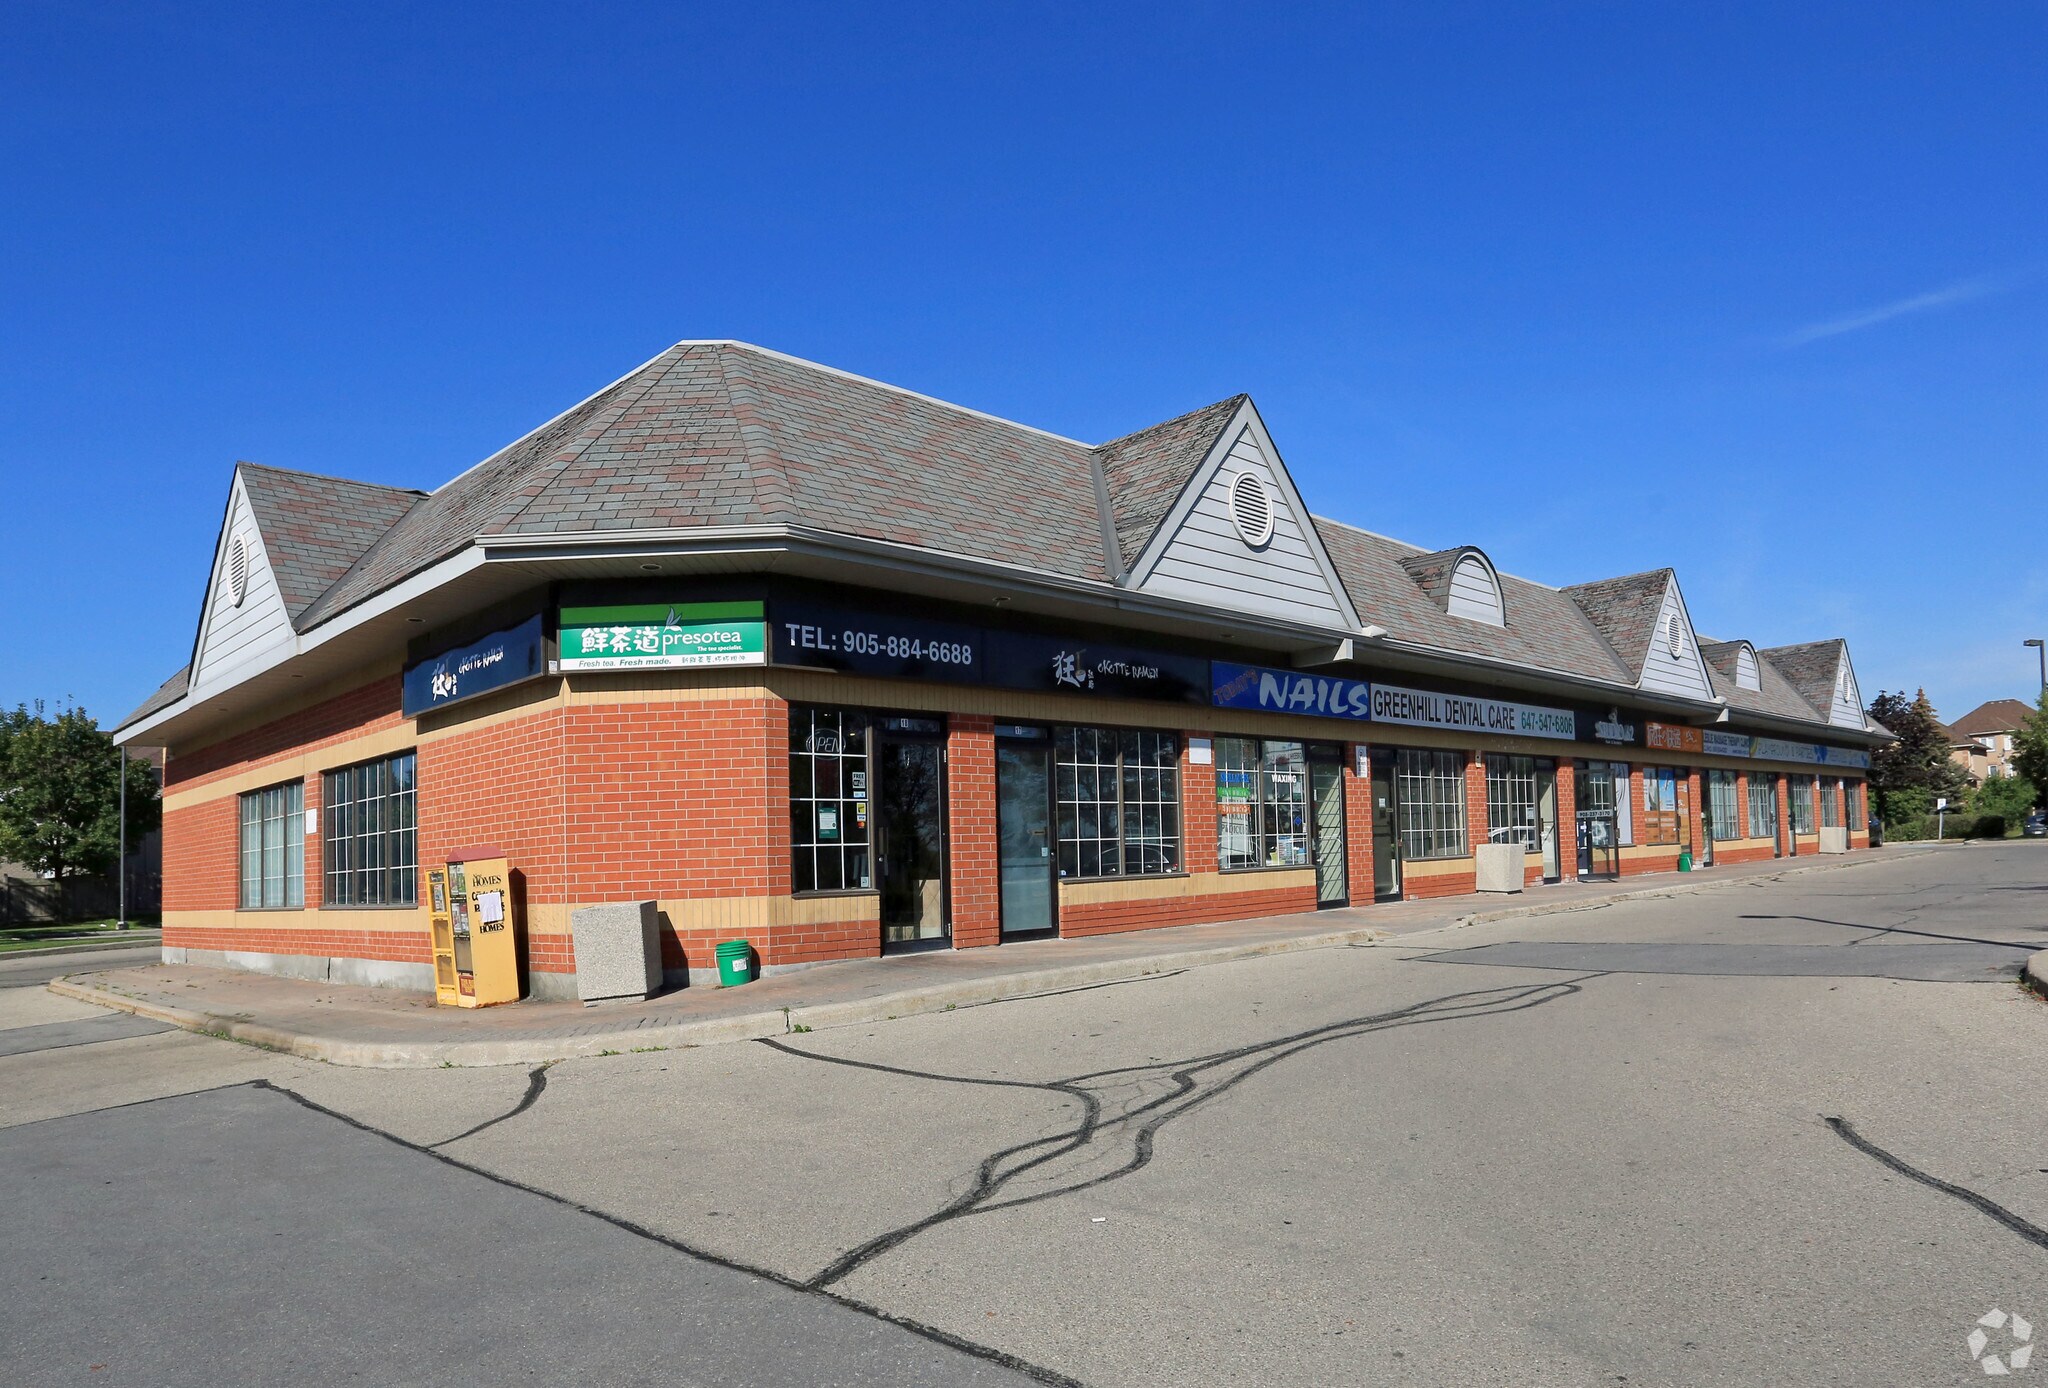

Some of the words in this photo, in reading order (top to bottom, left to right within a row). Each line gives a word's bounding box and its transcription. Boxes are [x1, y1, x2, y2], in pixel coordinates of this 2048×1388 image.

[581, 626, 659, 653] 鮮茶道
[663, 631, 741, 655] presotea
[786, 623, 837, 650] TEL:
[843, 630, 972, 665] 905-884-6688
[579, 659, 600, 668] Fresh
[645, 658, 672, 666] made.
[1132, 666, 1158, 679] RAMEN
[1259, 672, 1369, 717] NAILS
[1374, 690, 1441, 722] GREENHILL
[1444, 699, 1485, 727] DENTAL
[1488, 705, 1515, 730] CARE
[1521, 711, 1574, 735] 647-547-6806
[808, 736, 841, 753] OPEN
[1271, 774, 1297, 783] WAXING
[472, 875, 502, 888] HOMES
[480, 923, 505, 934] HOMES
